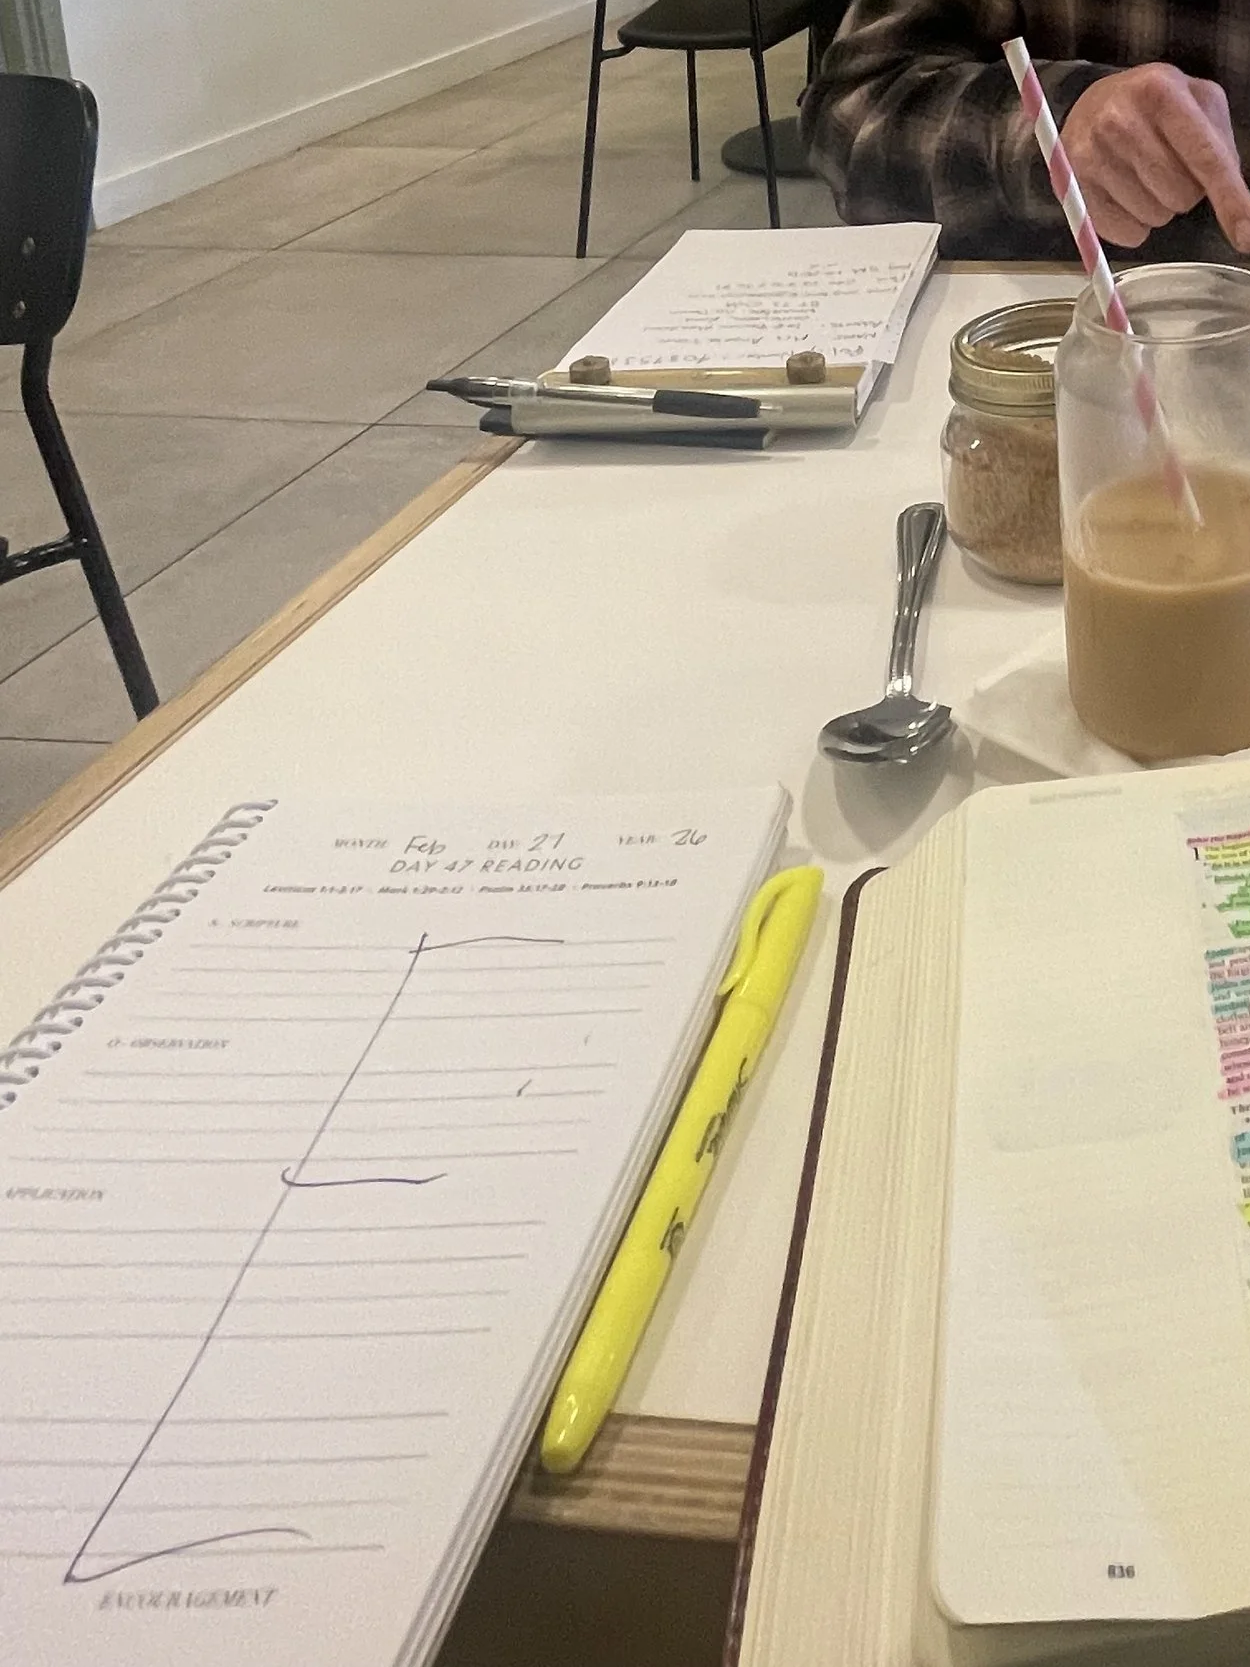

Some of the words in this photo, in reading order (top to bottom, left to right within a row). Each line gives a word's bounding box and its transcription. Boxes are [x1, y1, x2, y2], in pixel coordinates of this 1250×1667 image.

[403, 835, 446, 855] Feb
[670, 829, 707, 845] 26
[390, 860, 438, 873] DAY
[445, 860, 473, 872] 47
[480, 857, 584, 873] READING
[1231, 1104, 1250, 1115] The
